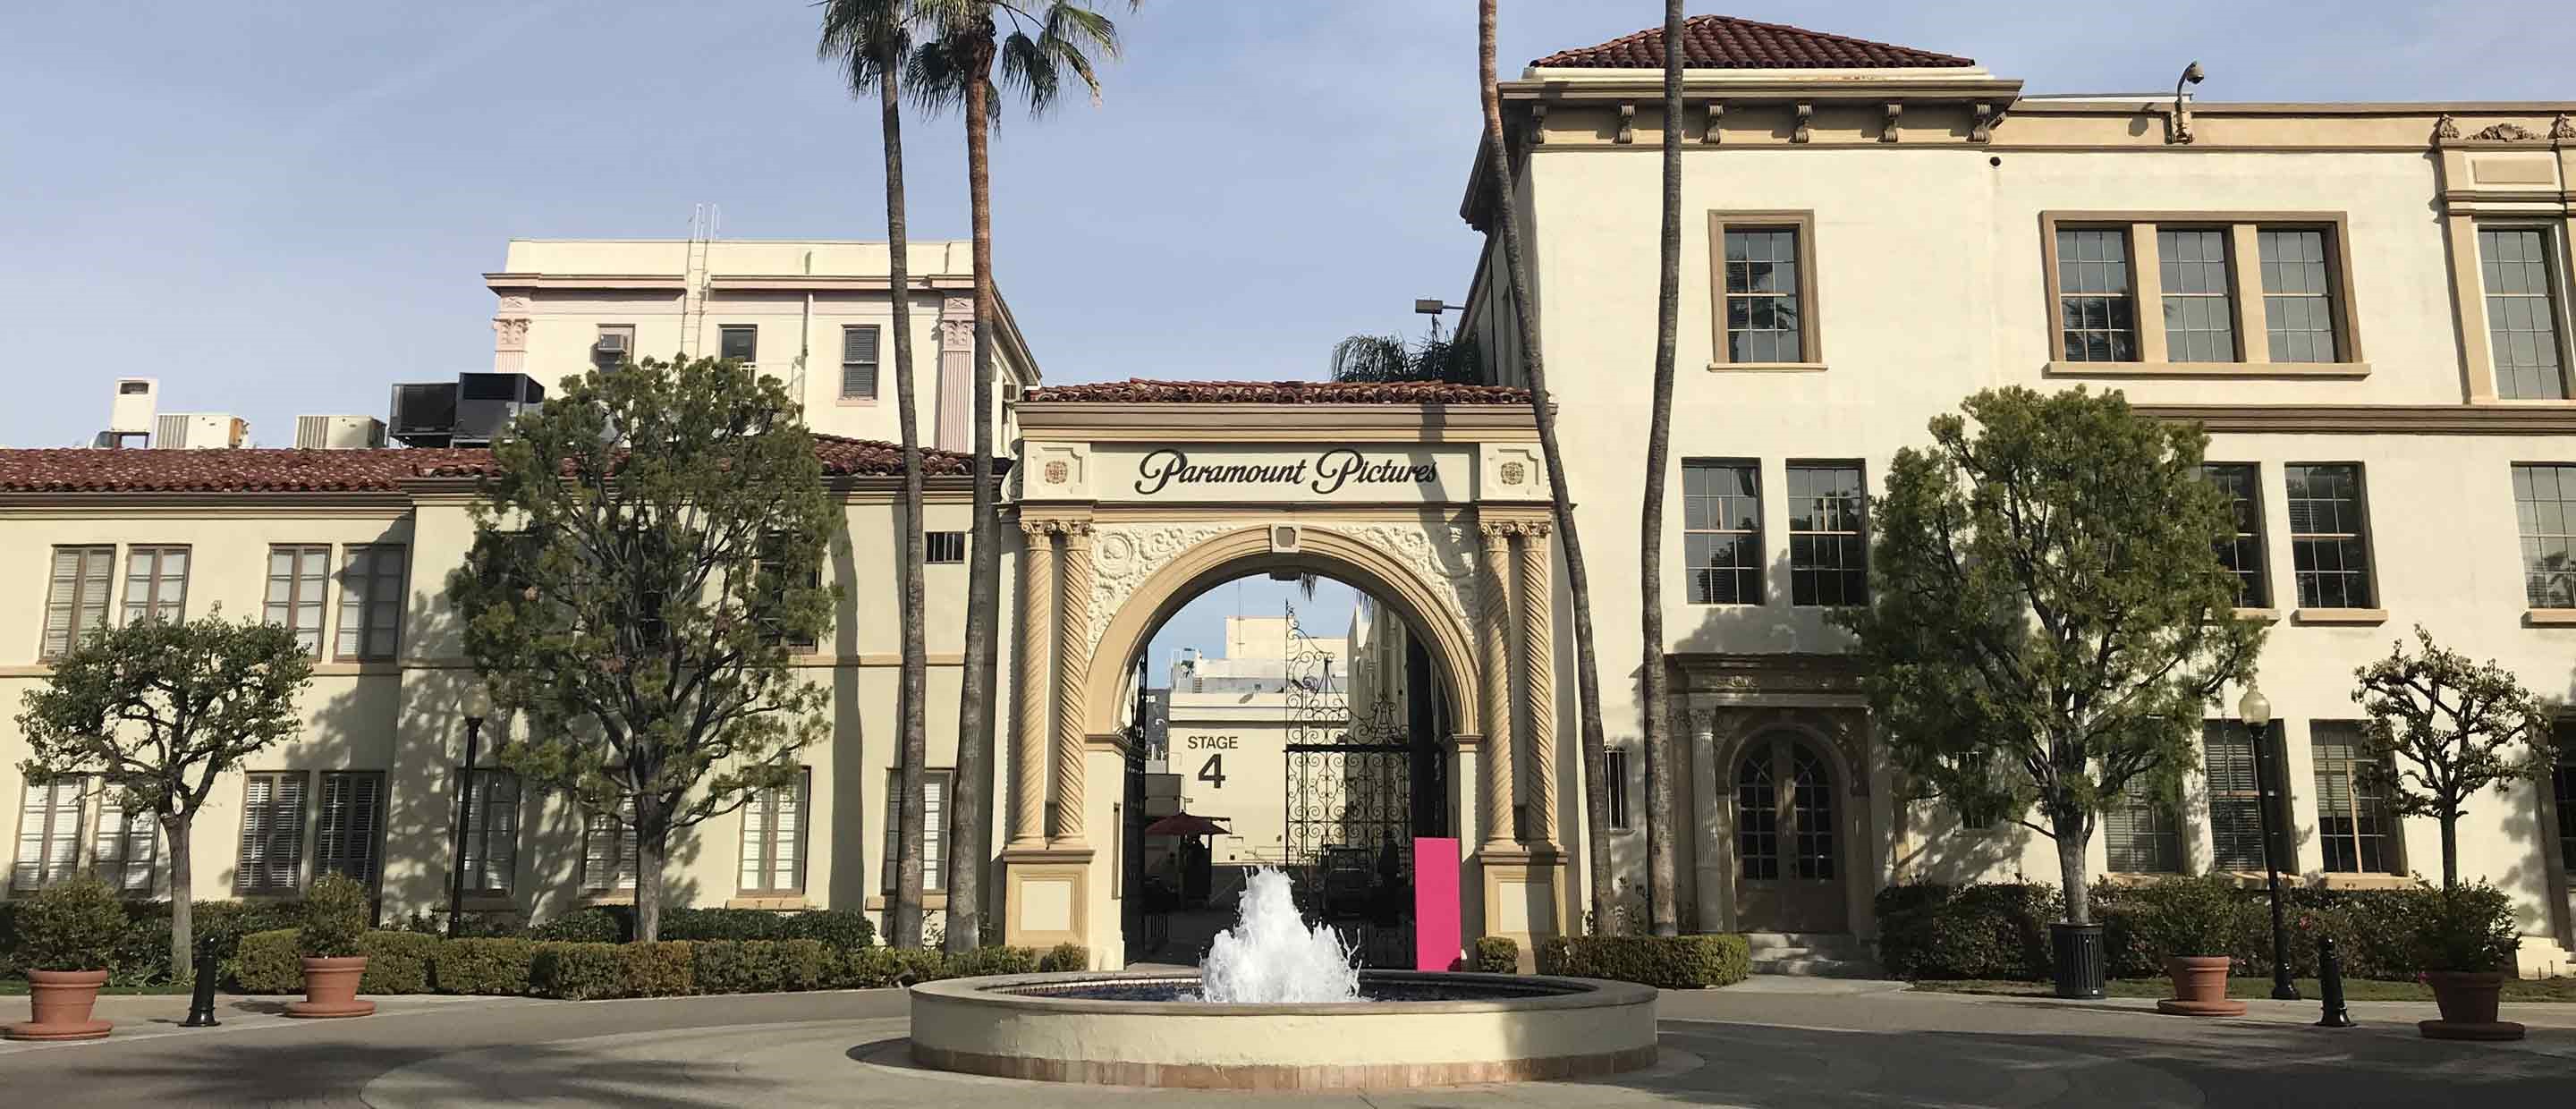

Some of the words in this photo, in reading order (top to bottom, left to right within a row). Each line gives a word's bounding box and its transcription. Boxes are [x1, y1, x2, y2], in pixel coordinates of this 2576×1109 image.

[1135, 449, 1307, 495] Paramount
[1311, 449, 1436, 494] Pictures
[1188, 736, 1239, 749] STAGE
[1198, 753, 1226, 789] 4
